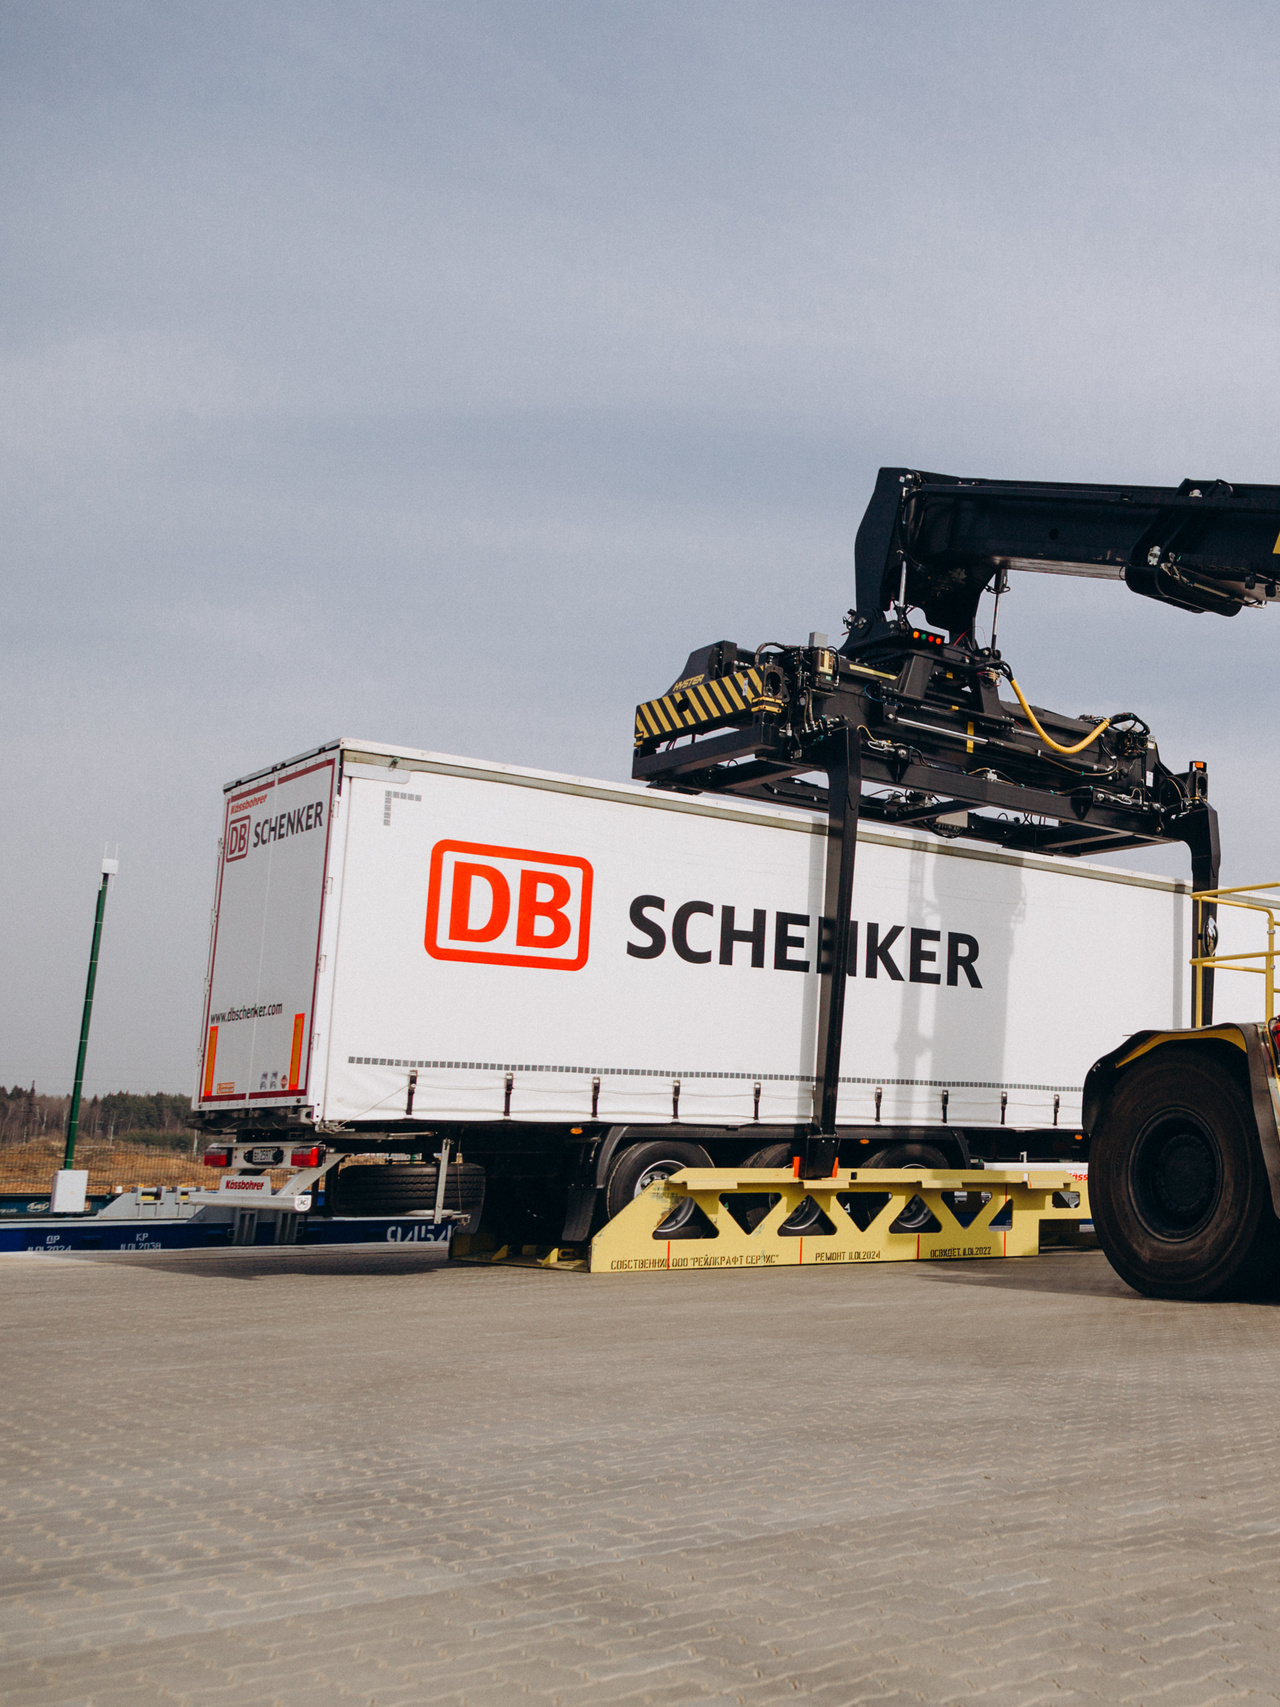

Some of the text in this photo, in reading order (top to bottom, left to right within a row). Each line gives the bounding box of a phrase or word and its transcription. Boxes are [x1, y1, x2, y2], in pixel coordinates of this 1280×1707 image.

[672, 673, 705, 692] HYSTER
[253, 801, 323, 848] SCHENKER
[210, 1003, 283, 1024] www.dbschenker.com
[225, 1179, 264, 1190] Kässbohrer
[672, 1258, 688, 1267] ООО
[815, 1251, 846, 1261] РЕМОНТ
